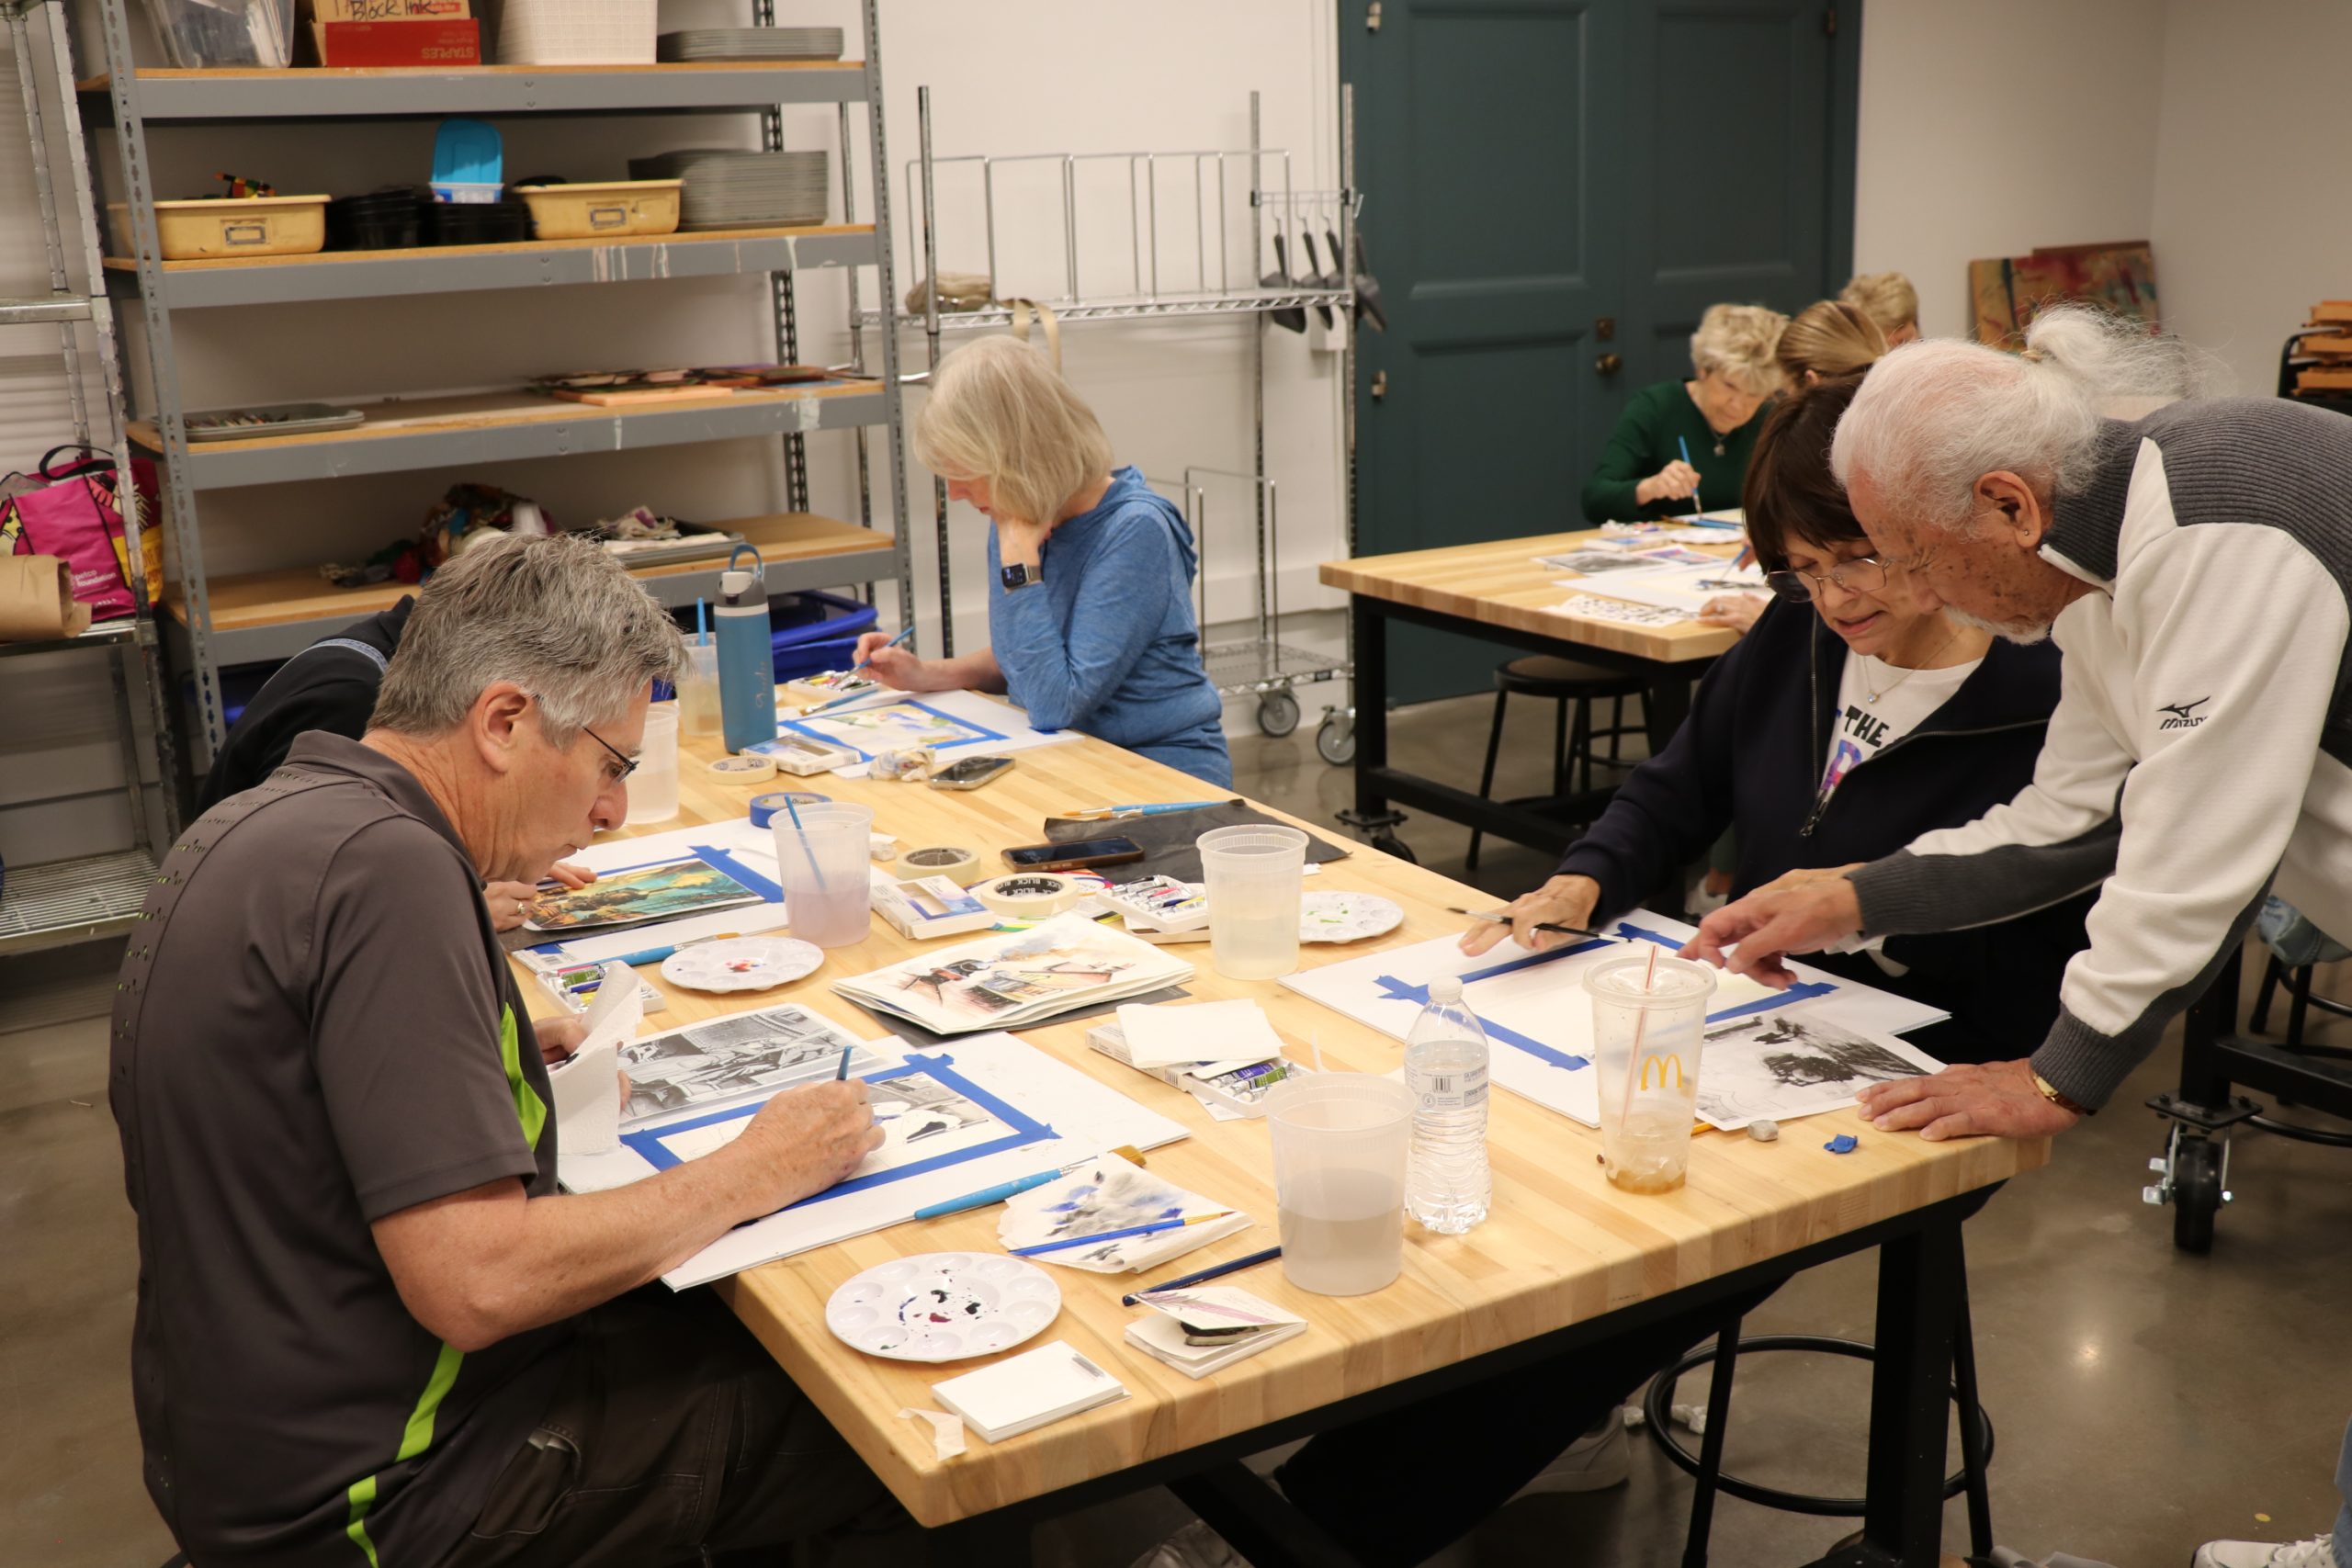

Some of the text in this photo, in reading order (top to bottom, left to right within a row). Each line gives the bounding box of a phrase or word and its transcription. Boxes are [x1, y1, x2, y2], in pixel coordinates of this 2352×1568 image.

[351, 0, 401, 21] Block
[405, 0, 440, 16] Ink
[422, 47, 475, 59] STAPLES
[76, 572, 117, 587] foundation
[1845, 705, 1890, 748] THE
[1013, 887, 1036, 896] BLICK
